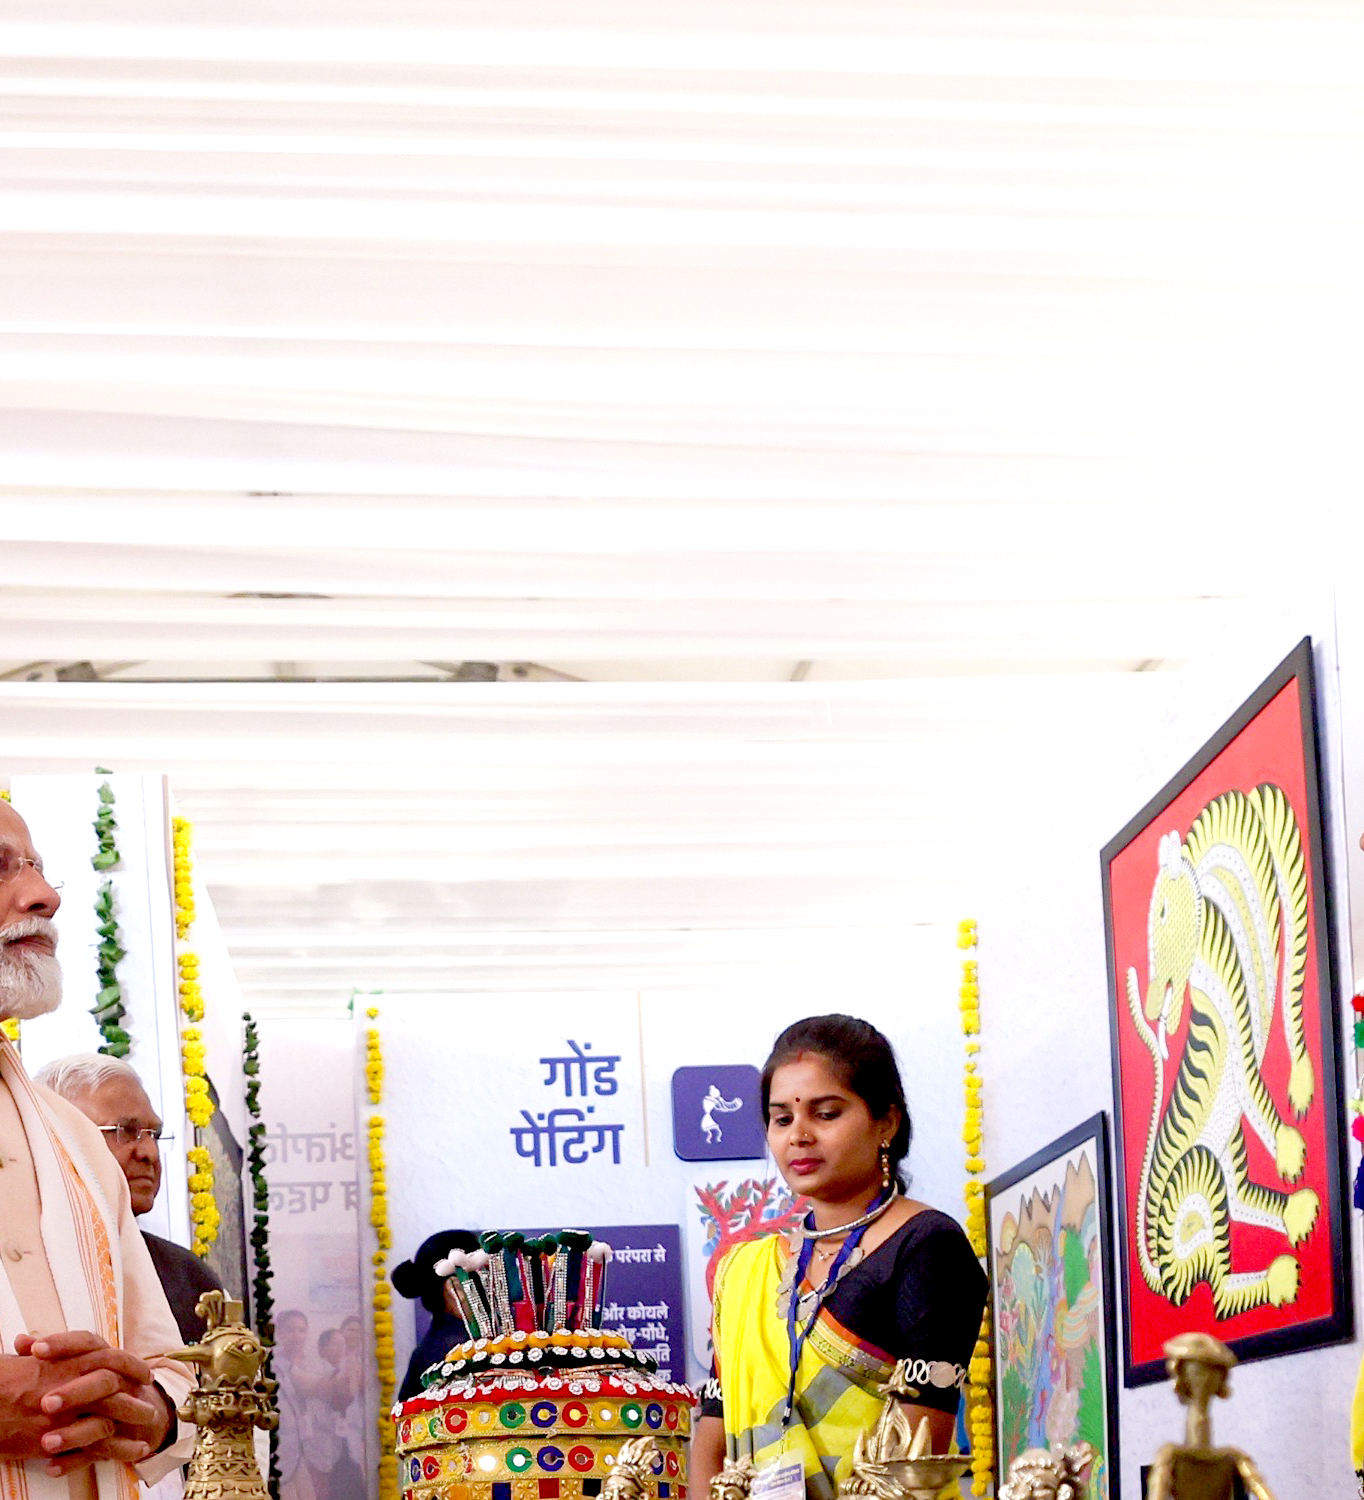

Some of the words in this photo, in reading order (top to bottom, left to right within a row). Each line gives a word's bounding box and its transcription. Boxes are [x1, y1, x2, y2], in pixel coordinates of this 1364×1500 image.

[539, 1039, 621, 1097] गोंड
[510, 1105, 625, 1167] पेंटिंग
[653, 1243, 667, 1262] से
[602, 1302, 625, 1320] और
[627, 1300, 669, 1320] कोयले
